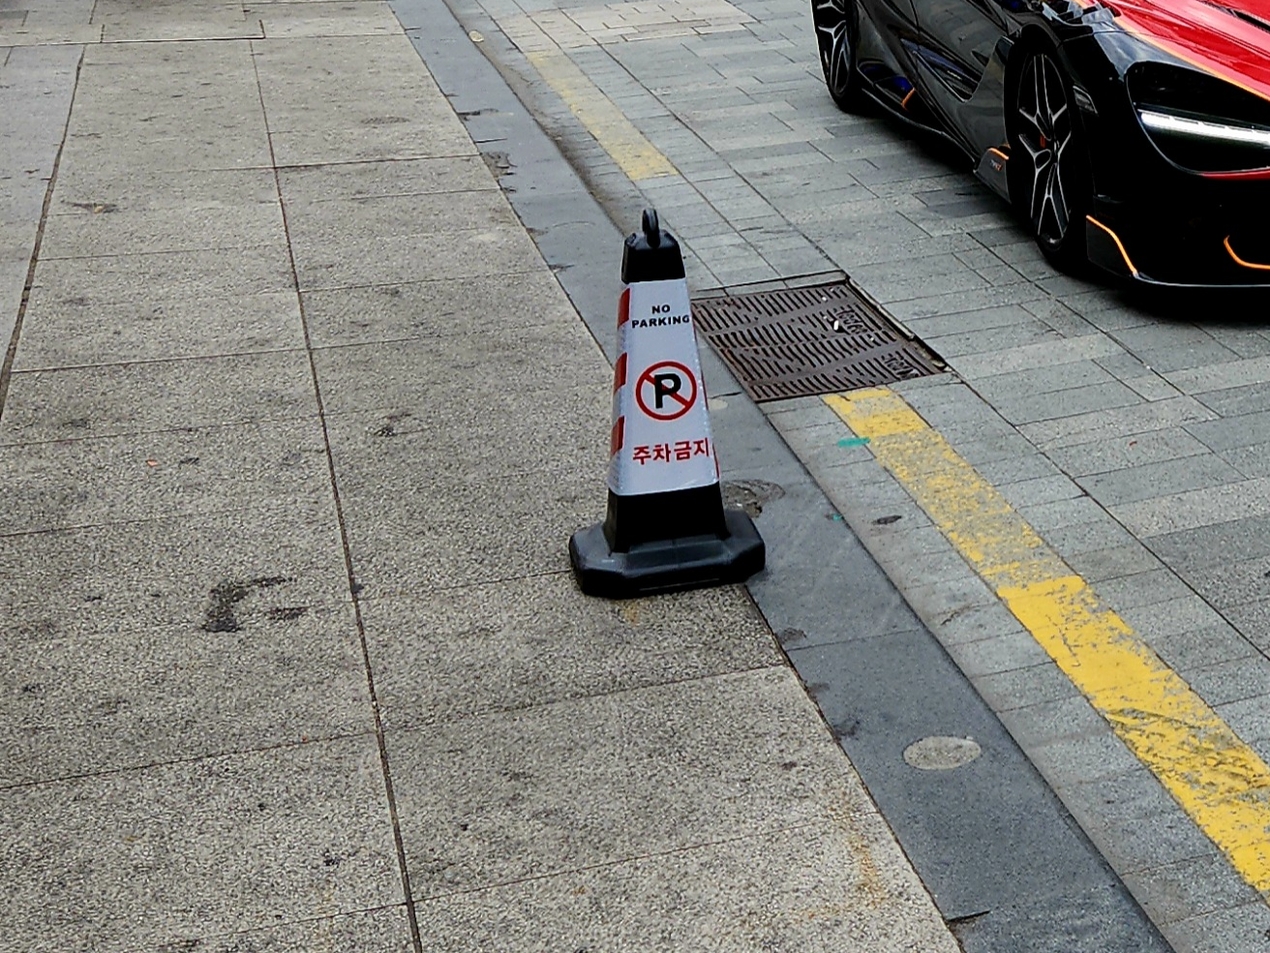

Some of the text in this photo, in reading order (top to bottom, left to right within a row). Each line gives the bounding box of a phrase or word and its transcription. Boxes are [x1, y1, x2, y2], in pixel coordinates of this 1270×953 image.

[651, 305, 671, 314] NO
[631, 314, 690, 329] PARKING
[654, 373, 682, 409] P
[632, 437, 711, 465] 주차금지
